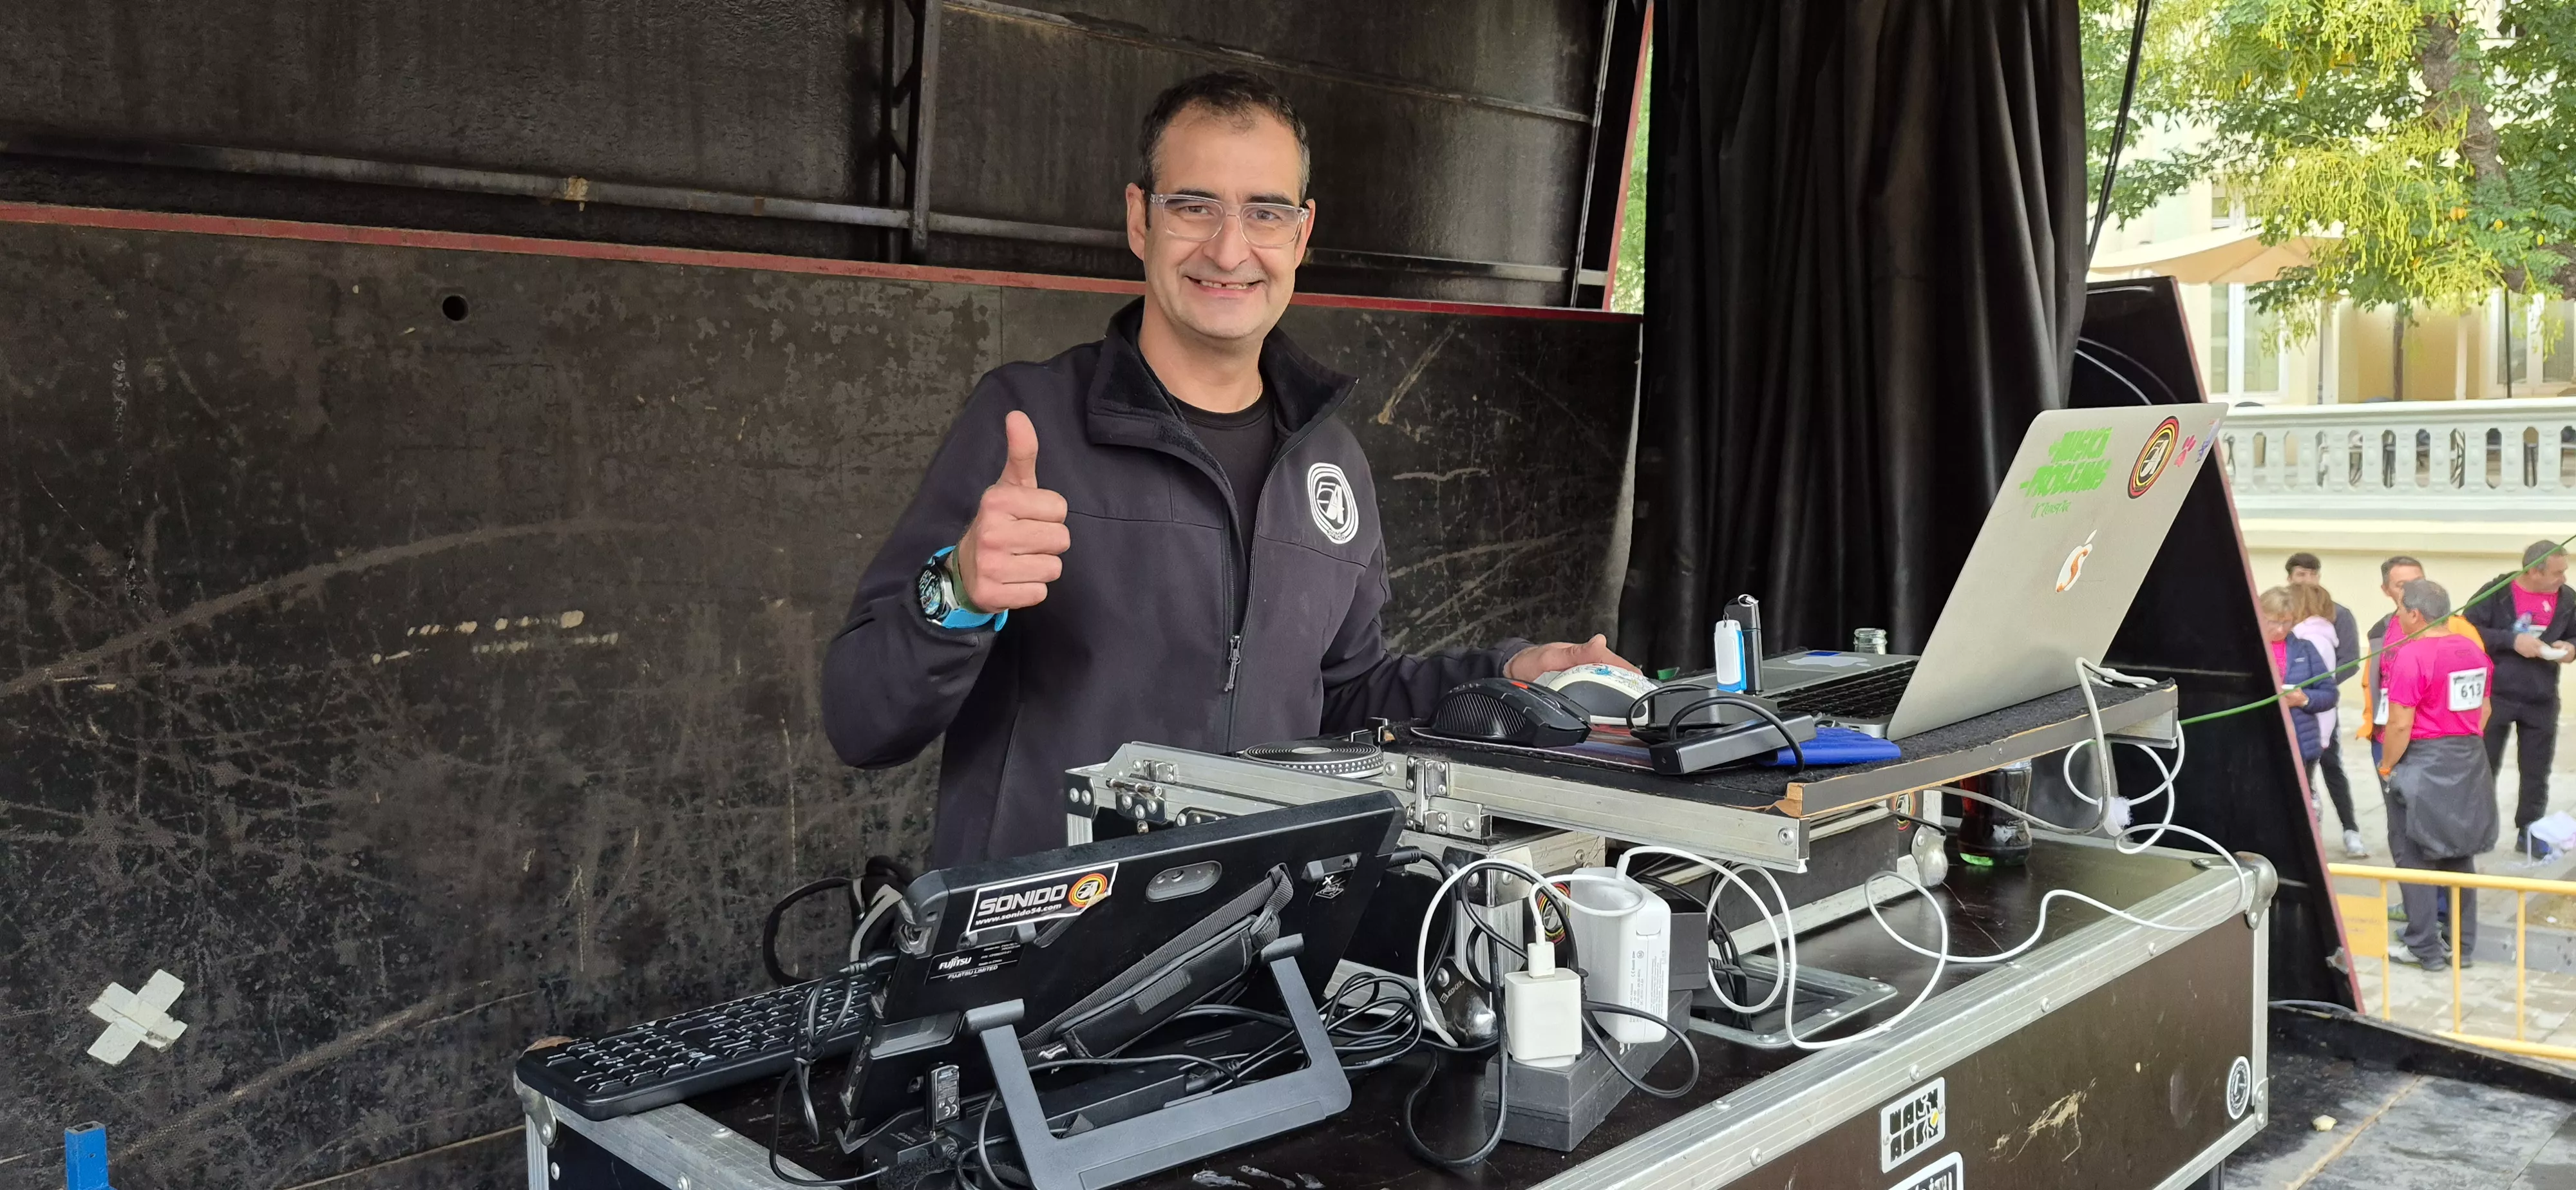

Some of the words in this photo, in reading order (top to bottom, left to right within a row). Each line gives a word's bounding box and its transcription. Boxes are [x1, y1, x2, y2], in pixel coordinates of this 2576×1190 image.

[2461, 683, 2481, 698] 613
[976, 883, 1068, 917] SONIDO
[974, 903, 1062, 926] www.sonido54.com
[947, 970, 974, 980] FUJITSU
[974, 965, 999, 974] LIMITED
